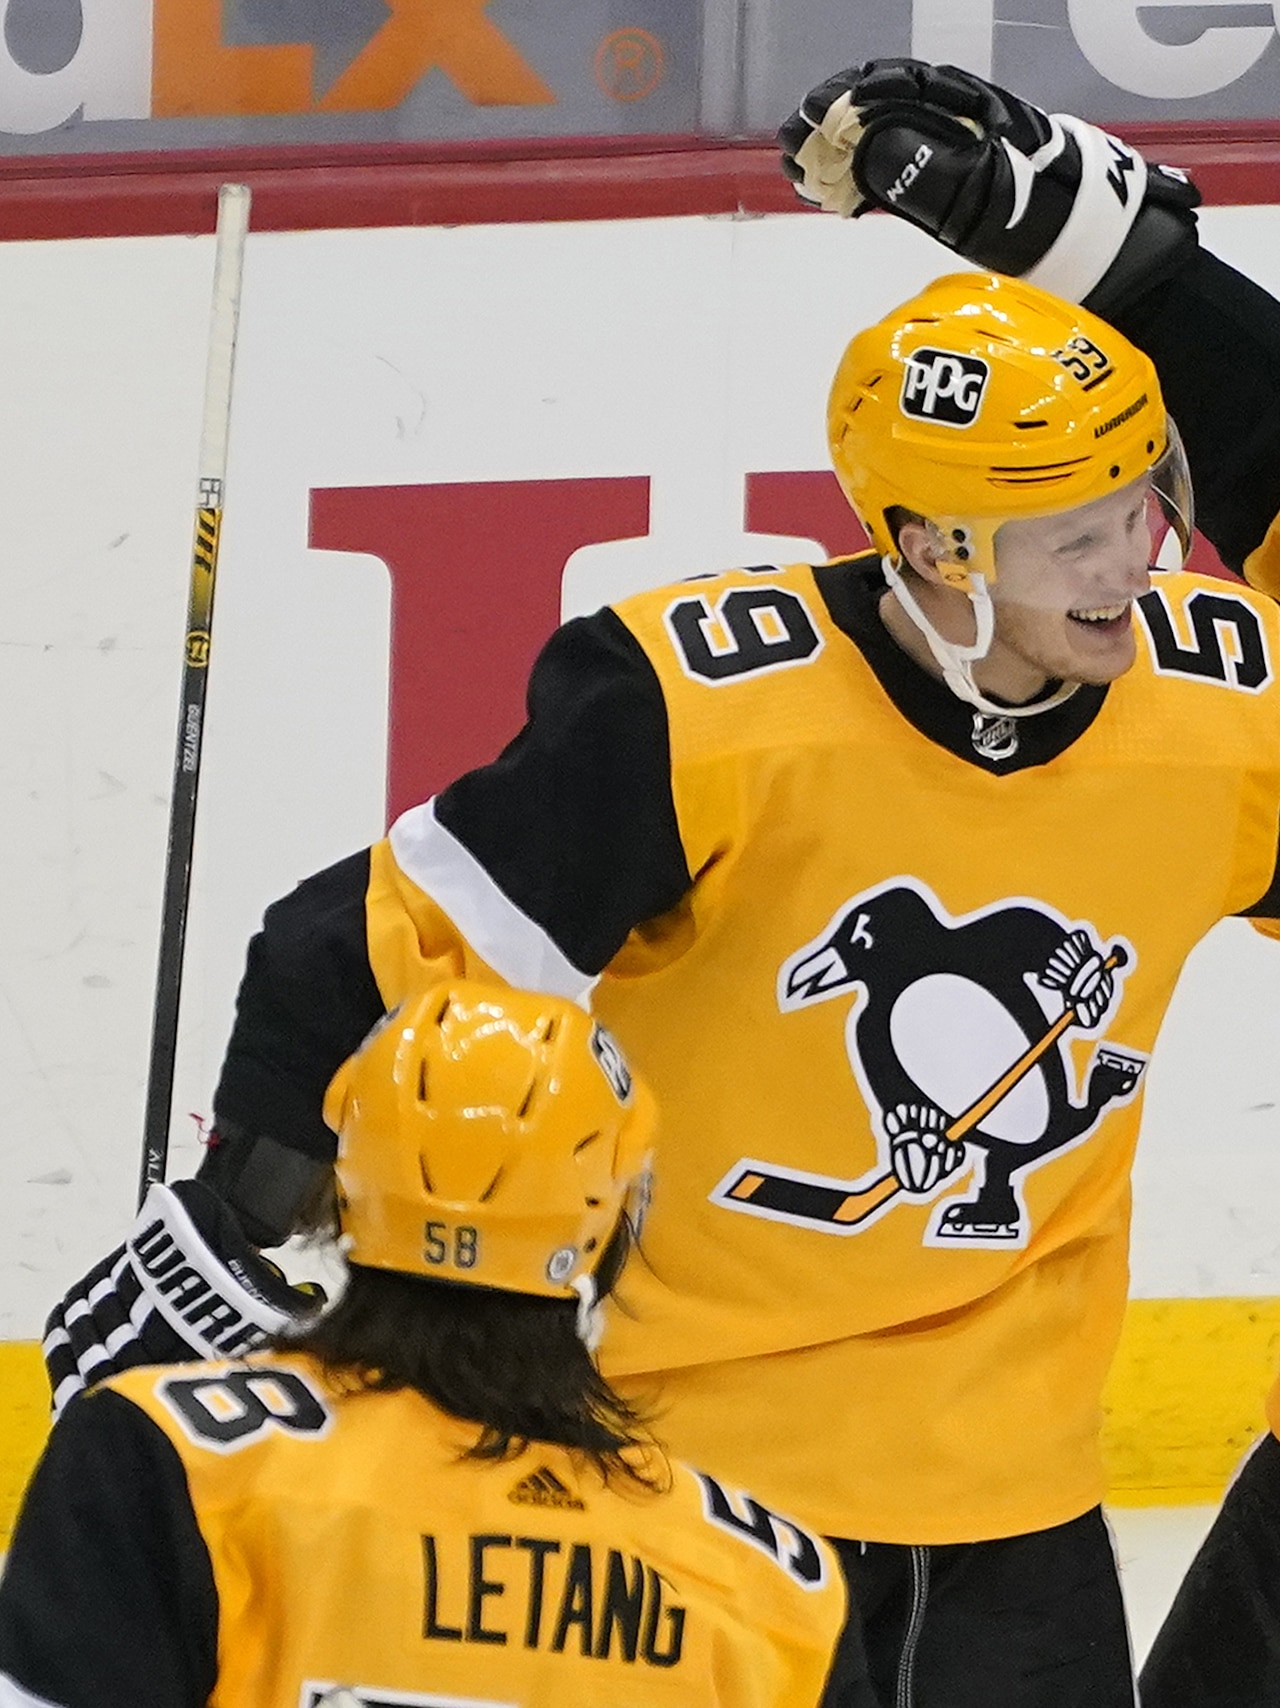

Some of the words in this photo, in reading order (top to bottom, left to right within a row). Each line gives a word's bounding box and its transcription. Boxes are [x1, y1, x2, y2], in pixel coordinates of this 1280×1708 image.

[886, 144, 933, 202] CCM
[905, 355, 984, 415] PPG
[1051, 336, 1109, 382] 59
[663, 566, 826, 687] 9
[1131, 568, 1275, 696] 5
[425, 1220, 478, 1268] 58
[420, 1533, 688, 1668] LETANG
